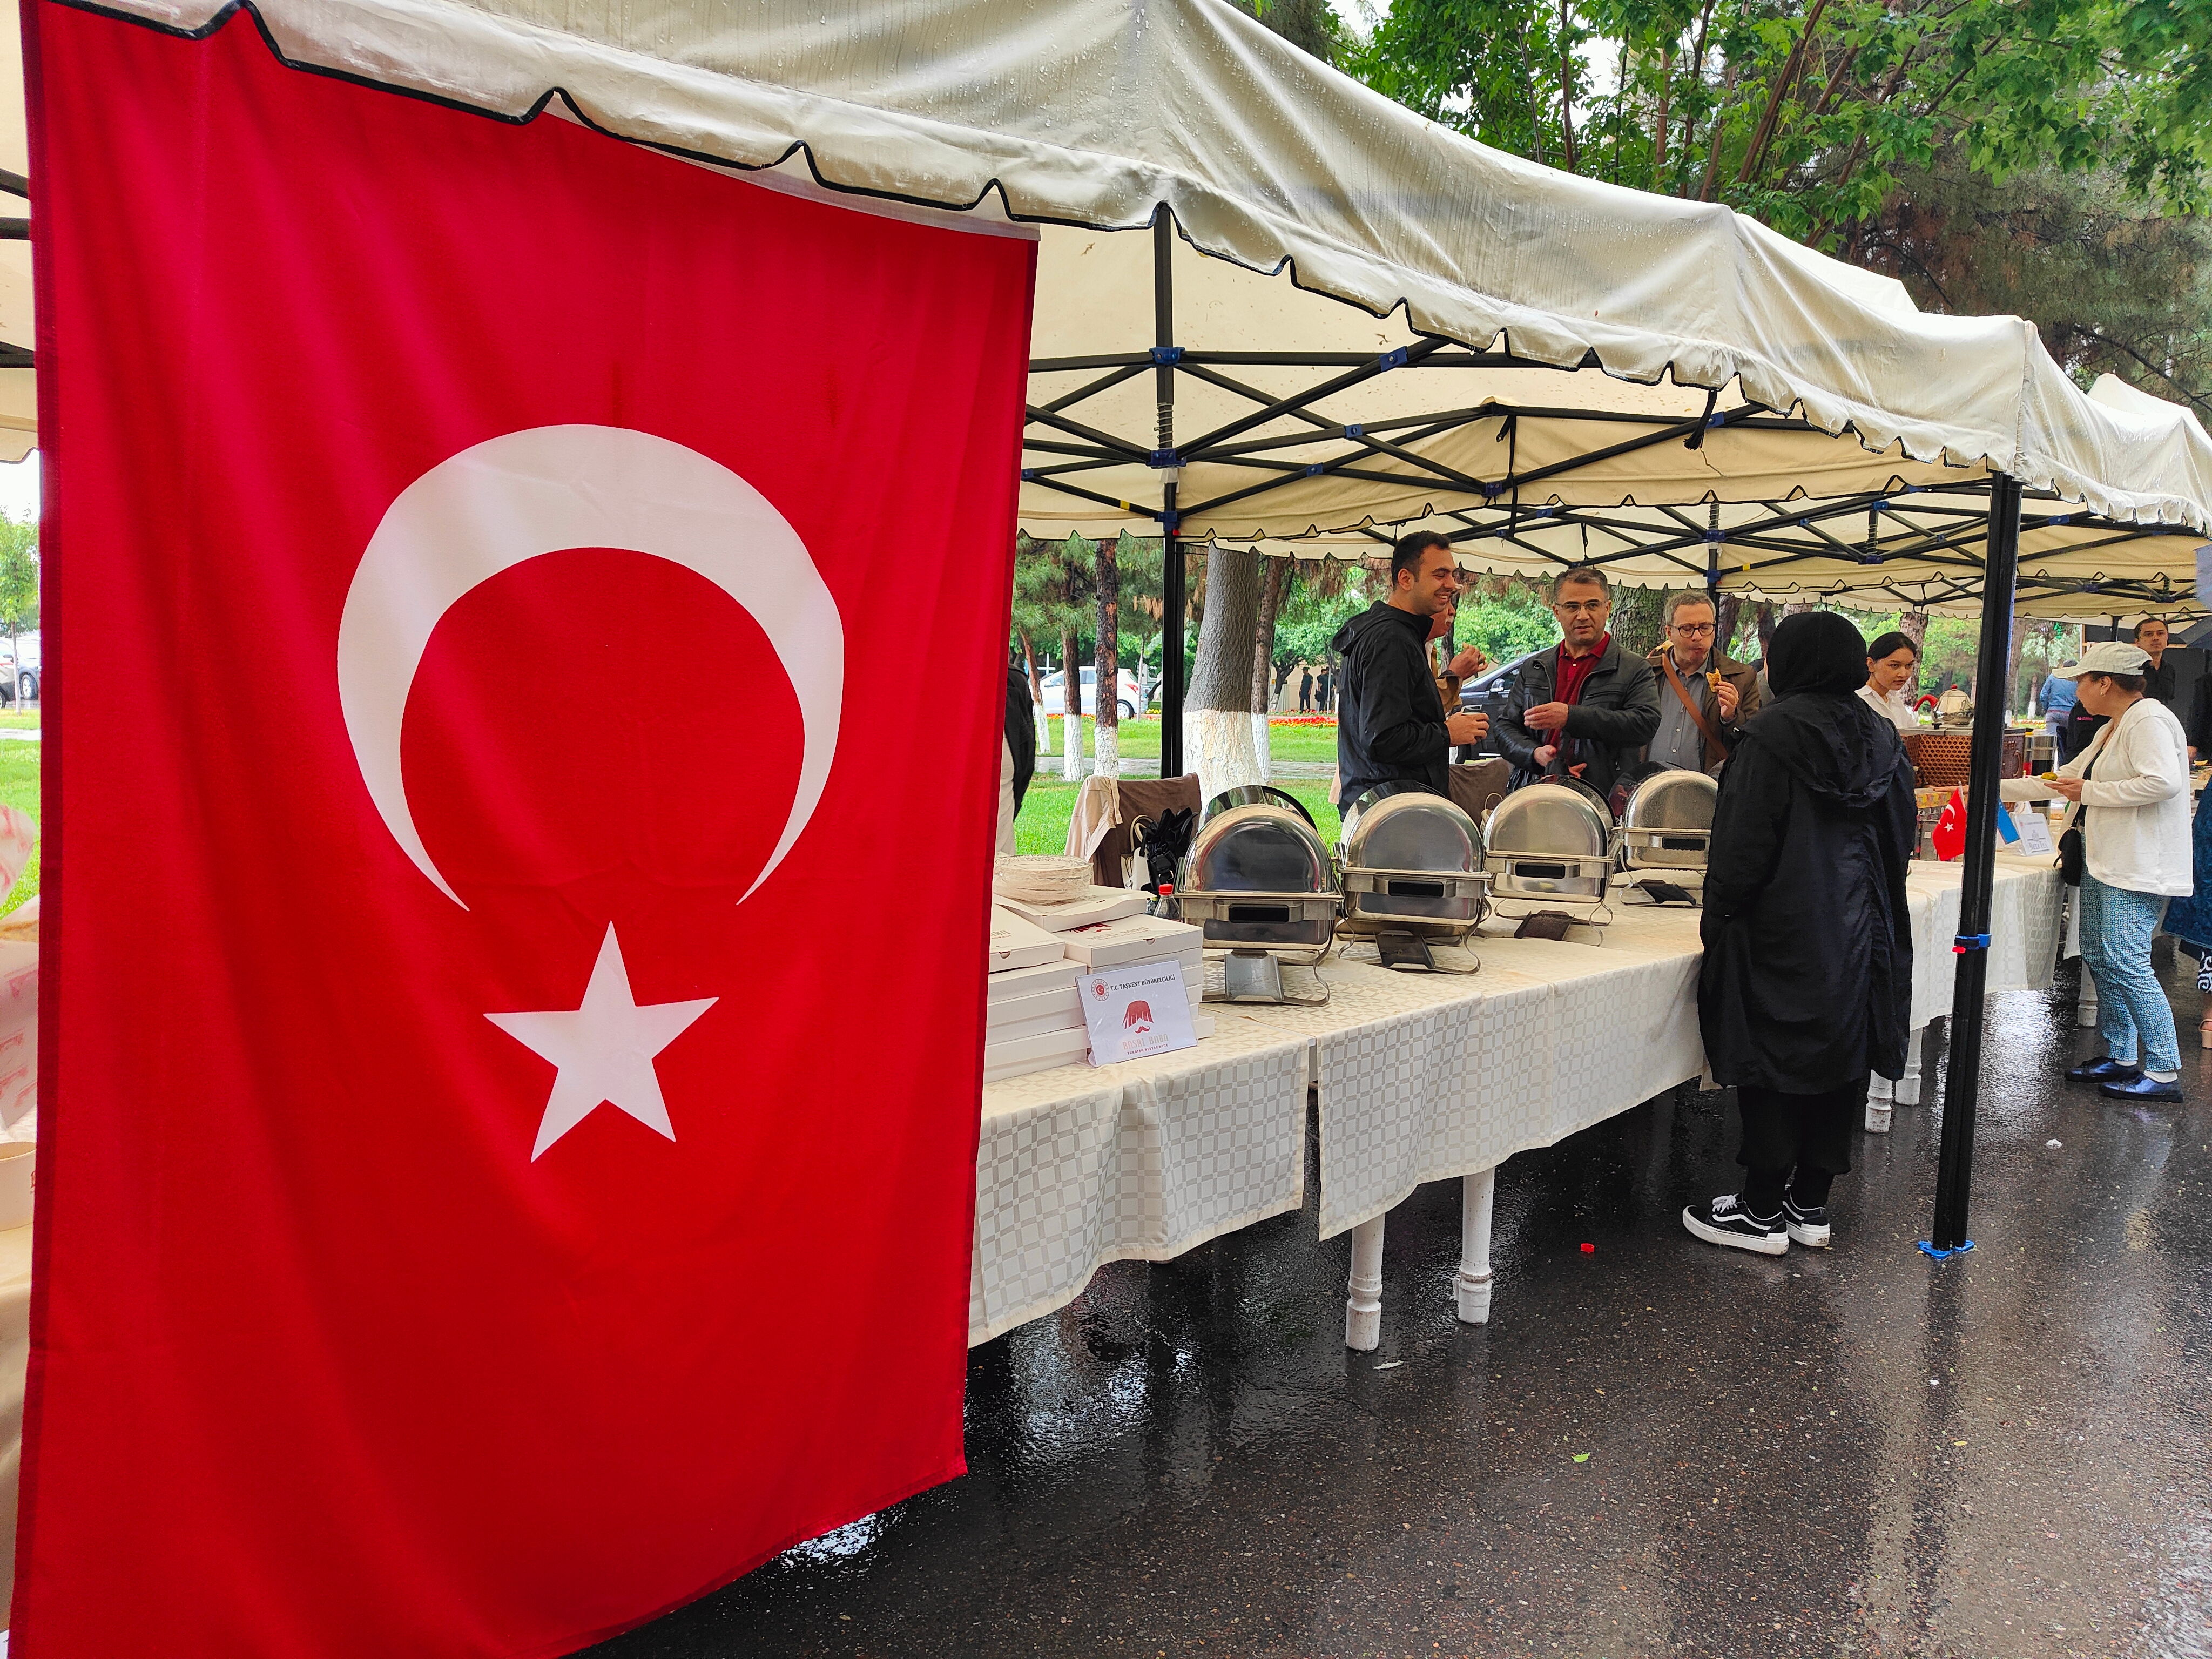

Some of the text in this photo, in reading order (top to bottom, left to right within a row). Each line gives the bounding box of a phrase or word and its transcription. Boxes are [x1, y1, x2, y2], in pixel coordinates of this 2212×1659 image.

[1119, 981, 1141, 989] TAŞKENT
[1141, 974, 1176, 986] BÜYÜKELÇİLİĞİ
[1123, 1033, 1169, 1050] BASRI BABA
